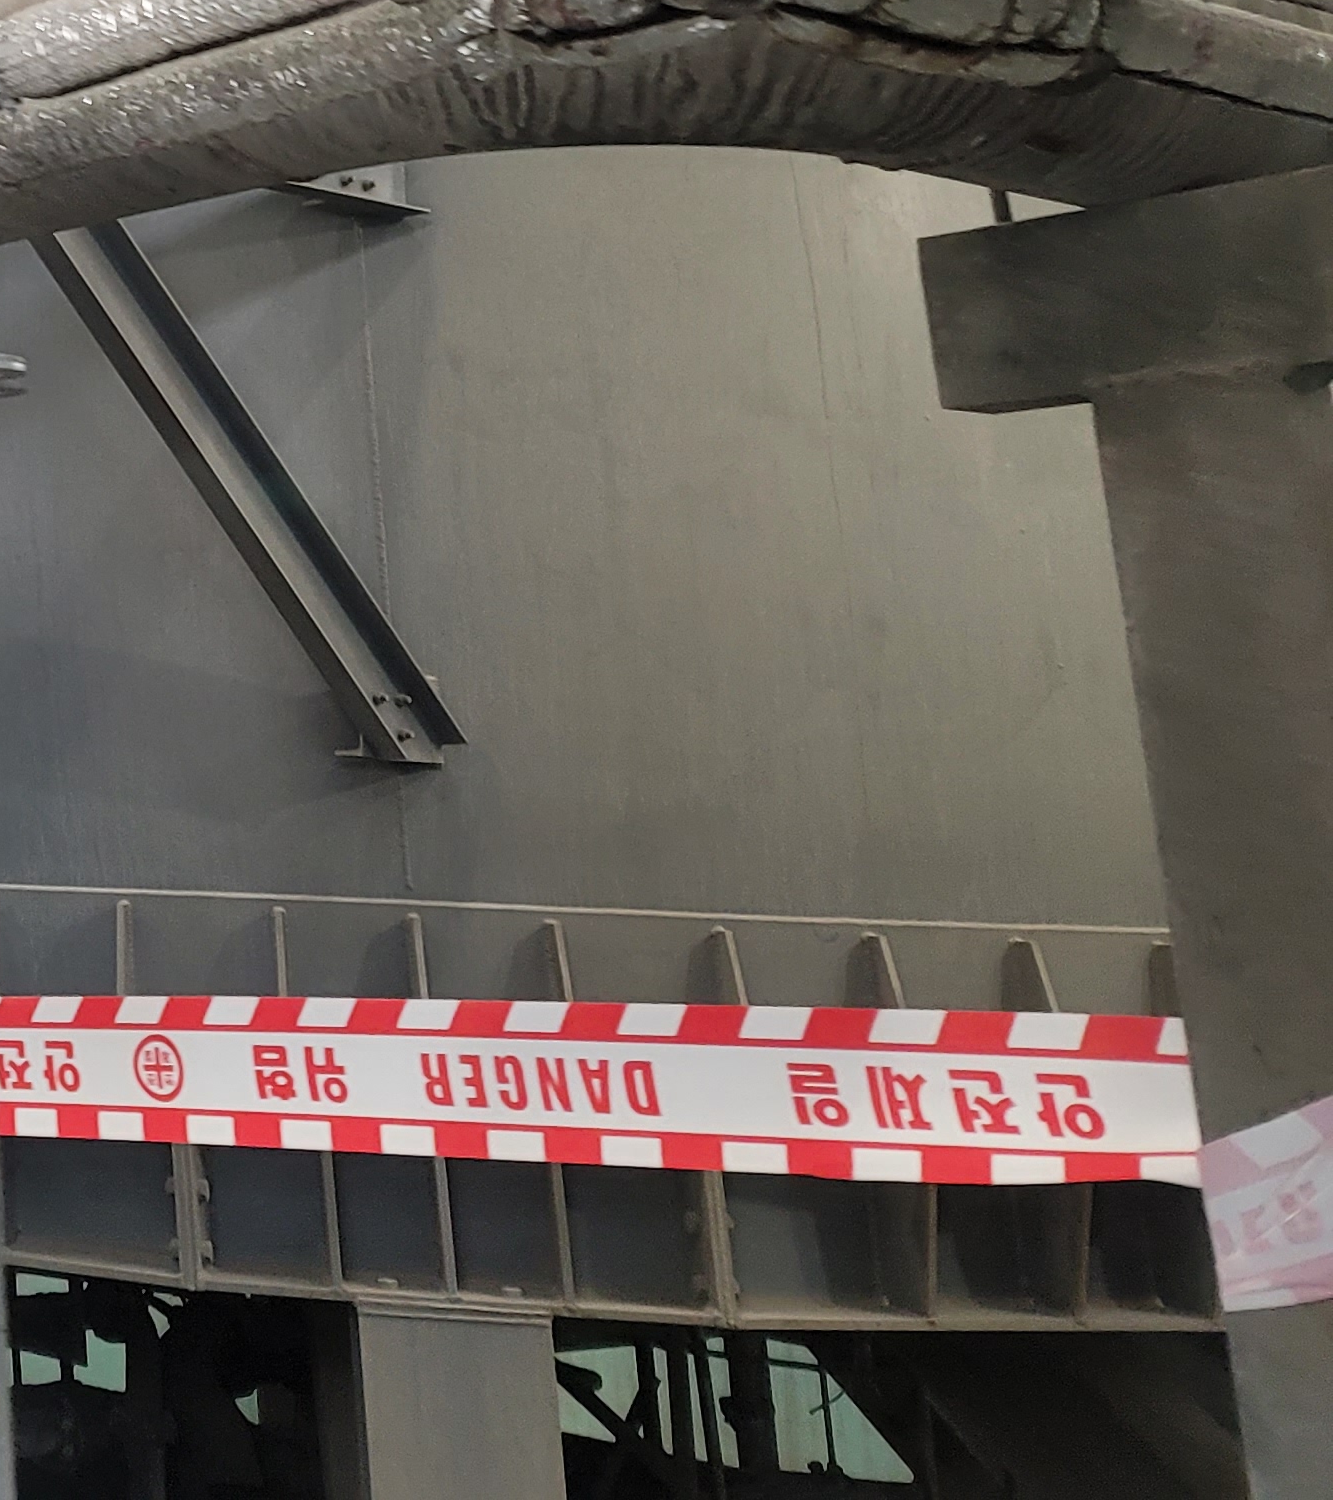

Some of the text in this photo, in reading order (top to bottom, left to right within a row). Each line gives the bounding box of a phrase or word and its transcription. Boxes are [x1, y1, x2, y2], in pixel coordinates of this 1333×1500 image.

[251, 1043, 350, 1104] 위험
[419, 1052, 662, 1118] DANGER
[785, 1061, 1107, 1141] 안전제일
